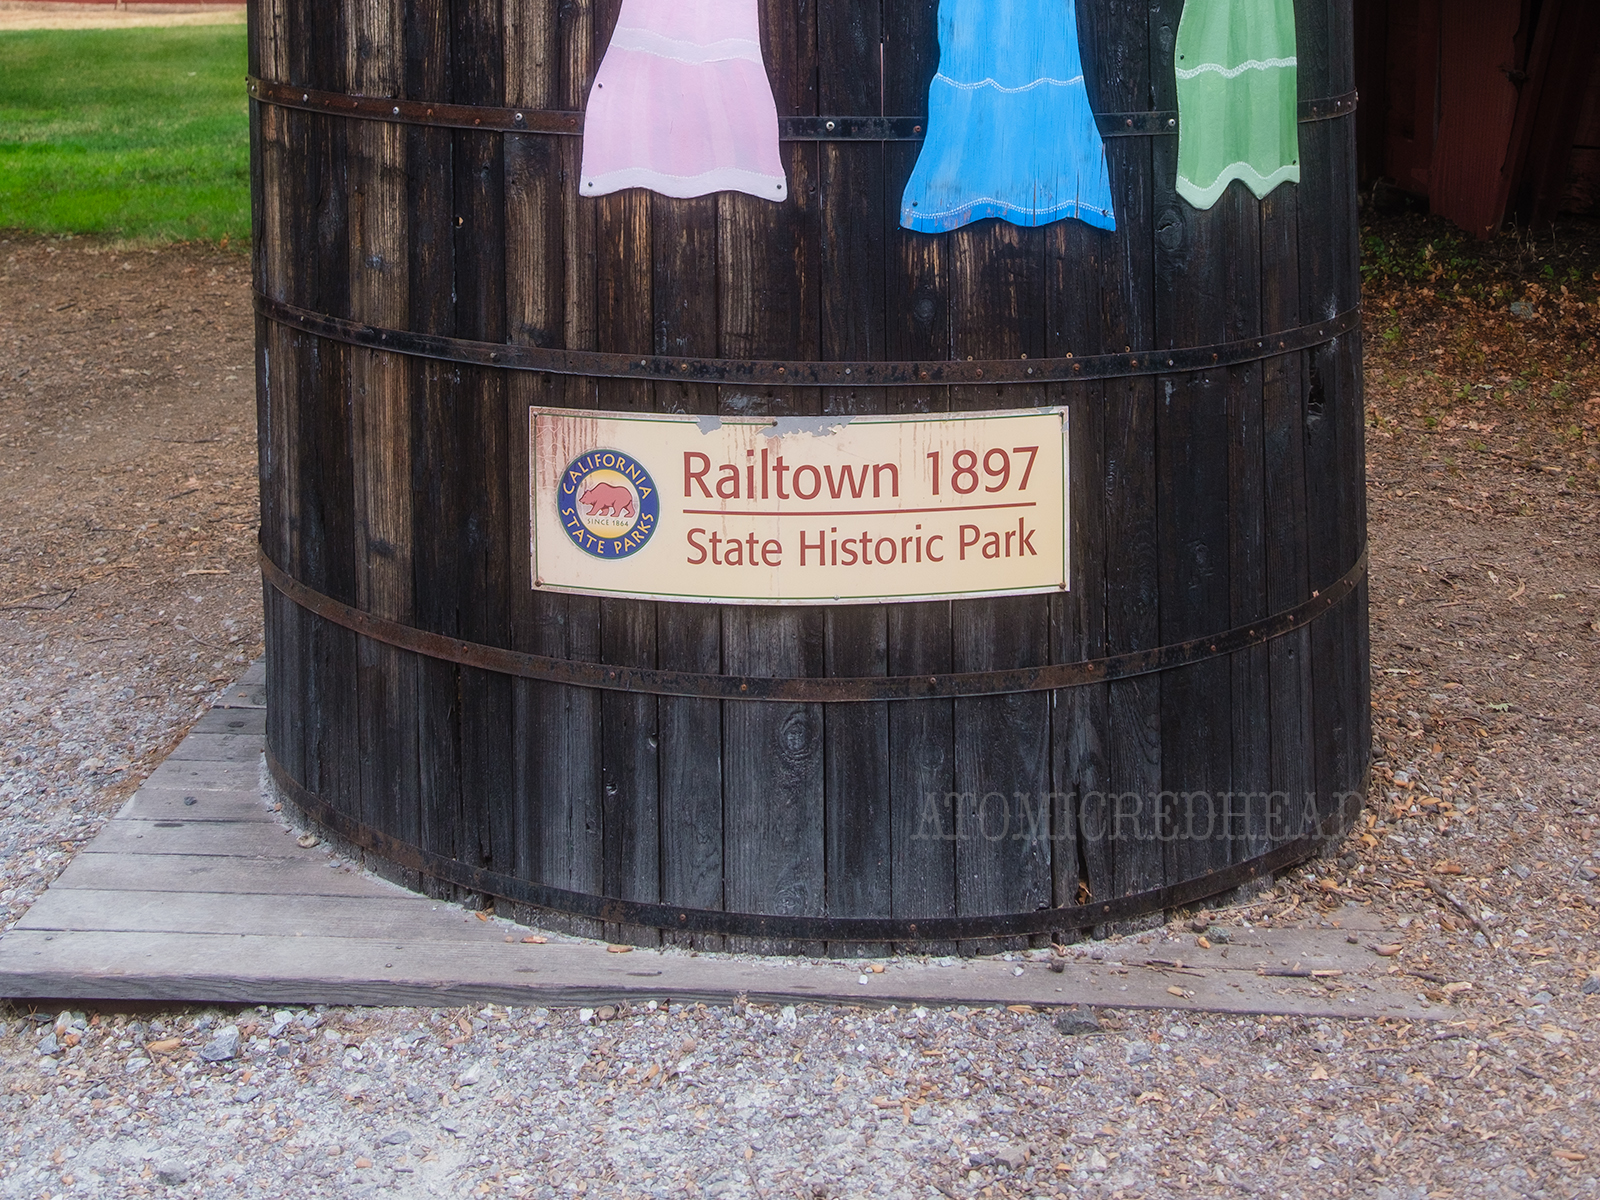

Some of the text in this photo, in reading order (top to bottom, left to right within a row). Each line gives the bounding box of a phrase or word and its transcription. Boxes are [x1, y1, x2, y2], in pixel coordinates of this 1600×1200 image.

[563, 453, 652, 499] CALIFORNIA
[683, 445, 1040, 500] Railtown 1897
[562, 507, 654, 554] STATE PARKS
[587, 518, 629, 527] SINCE 1864
[686, 516, 1038, 567] State Historic Park
